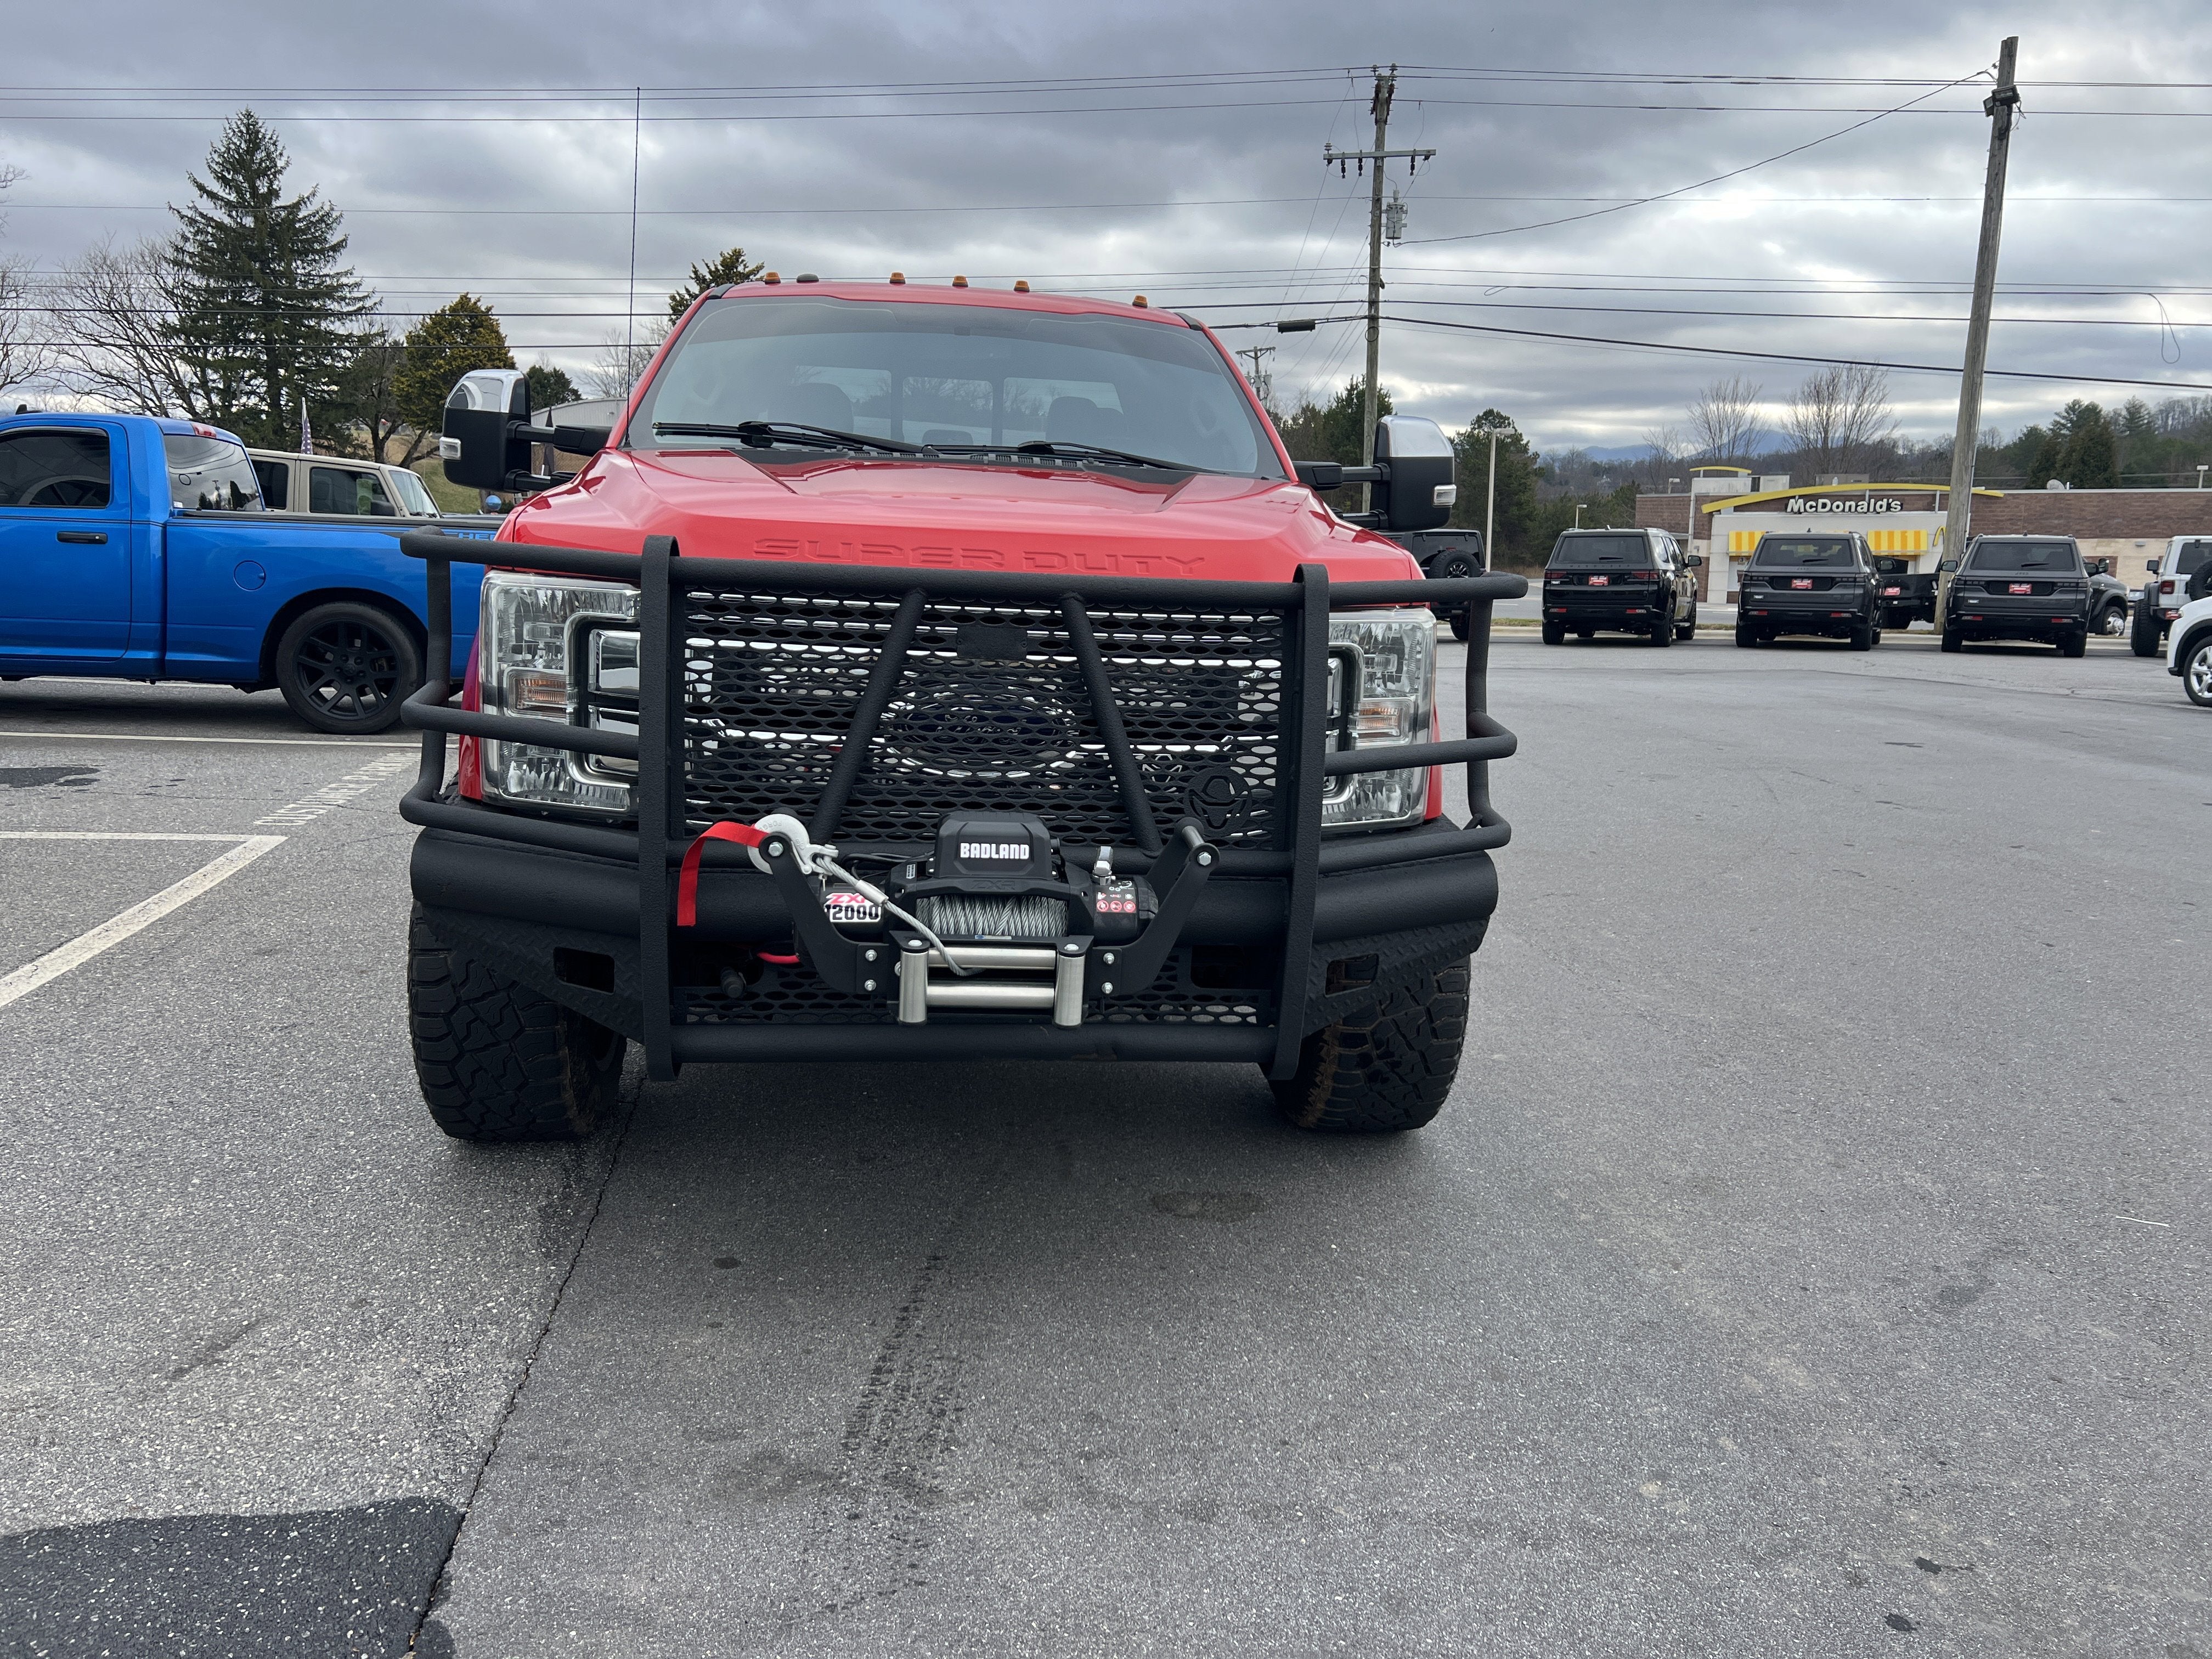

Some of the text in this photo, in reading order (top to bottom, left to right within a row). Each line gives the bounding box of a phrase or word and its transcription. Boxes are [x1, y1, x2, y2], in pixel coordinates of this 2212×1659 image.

[1786, 498, 1901, 512] McDonald's
[458, 532, 495, 541] HE
[753, 538, 1206, 575] SUPER DUTY
[960, 843, 1030, 860] BADLAND
[970, 880, 1015, 890] ZXR
